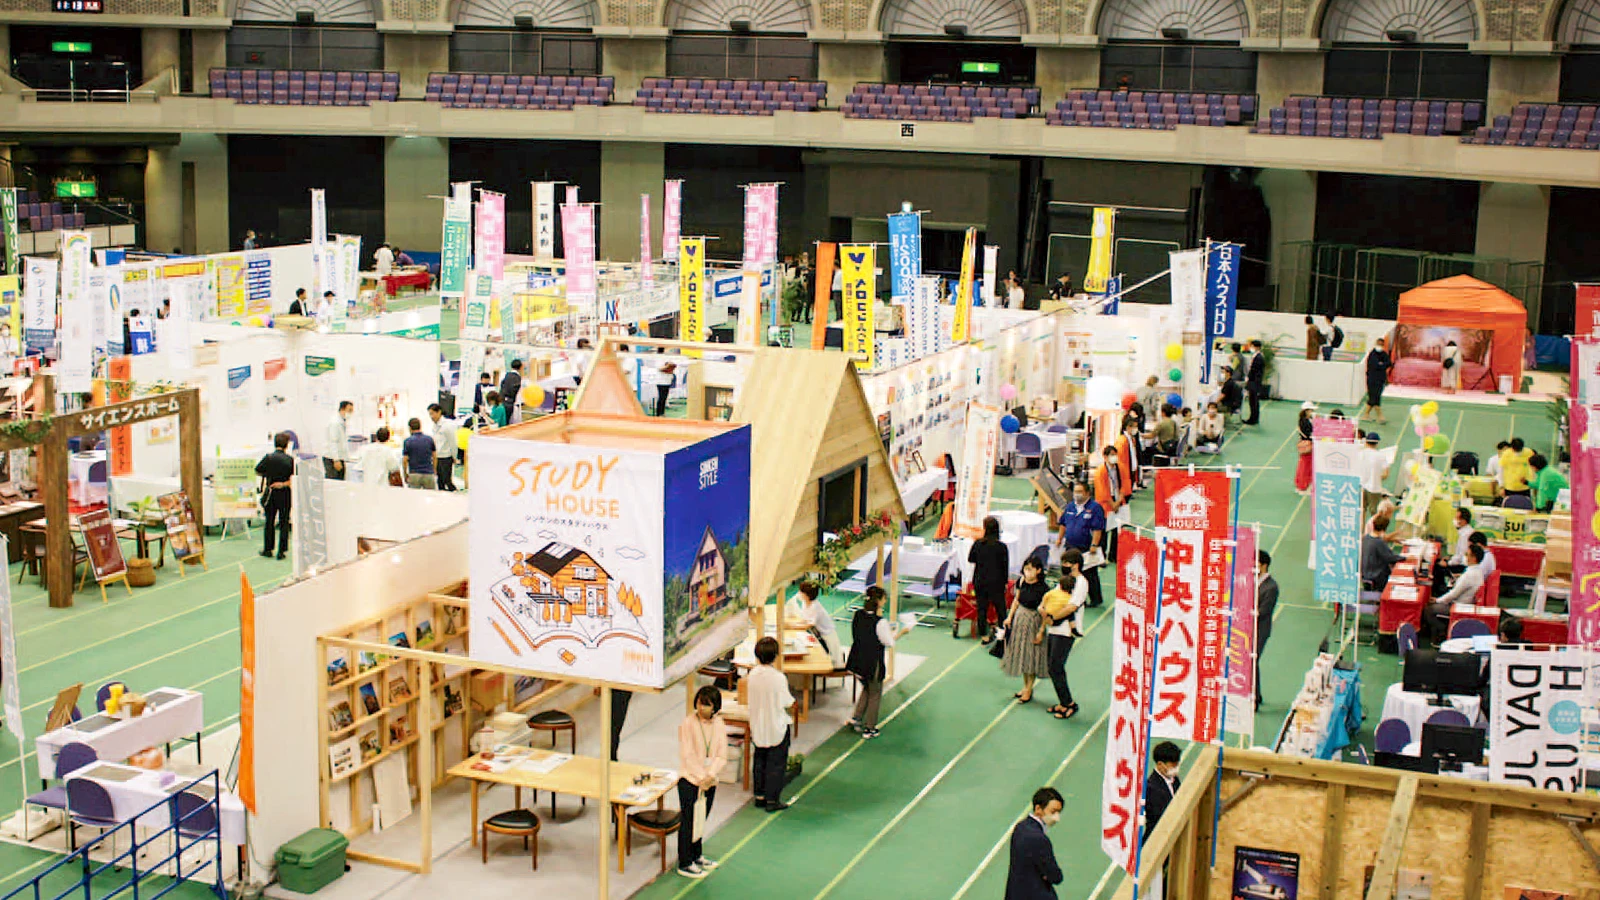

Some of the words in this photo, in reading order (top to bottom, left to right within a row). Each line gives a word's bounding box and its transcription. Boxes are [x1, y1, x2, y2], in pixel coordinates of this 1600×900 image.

[901, 123, 914, 137] 西
[1213, 246, 1232, 335] 日本ハウスHD
[80, 396, 180, 430] サイエンスホーム
[508, 454, 619, 497] STUDY
[698, 470, 719, 490] STYLE
[546, 495, 620, 519] HOUSE
[1168, 518, 1210, 529] HOUSE
[1154, 538, 1195, 727] 中央ハウス
[1103, 611, 1140, 849] 中央ハウス
